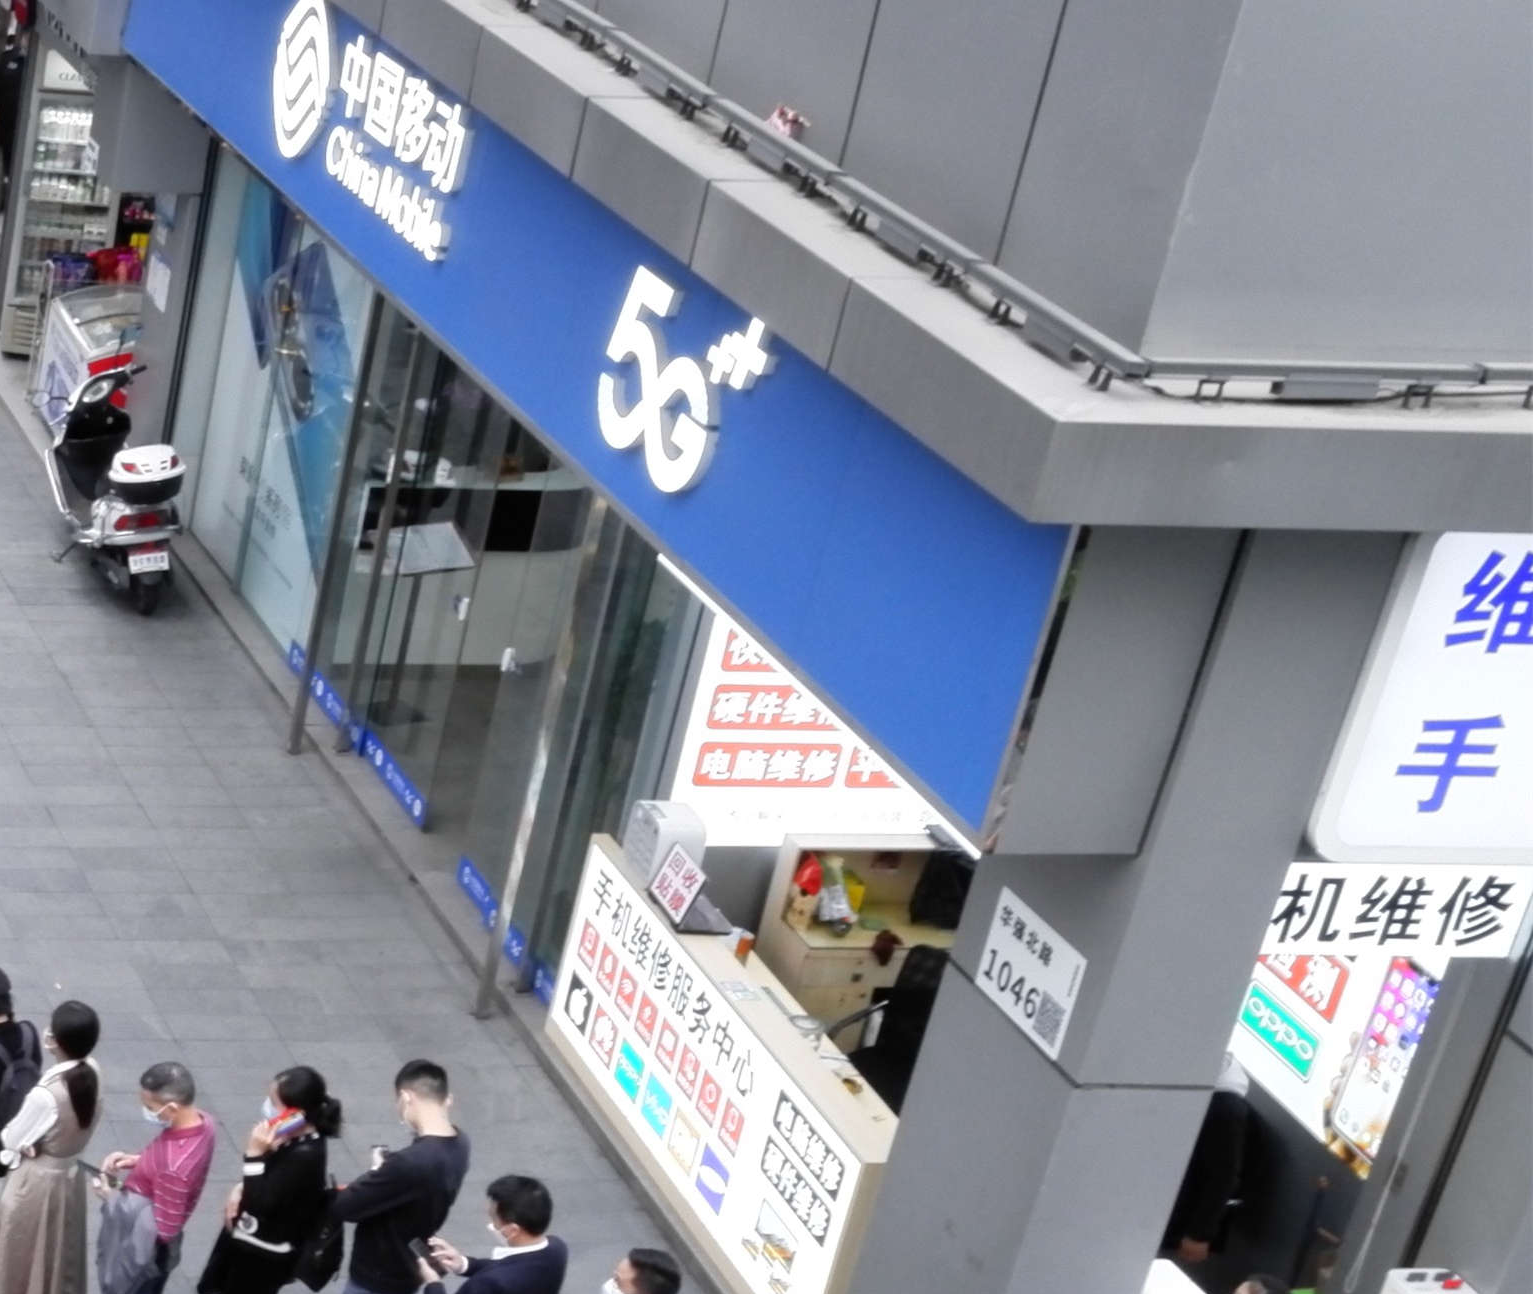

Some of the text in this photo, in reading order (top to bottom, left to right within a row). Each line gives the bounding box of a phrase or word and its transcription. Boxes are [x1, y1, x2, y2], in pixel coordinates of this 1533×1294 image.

[339, 34, 467, 195] 中国移动
[325, 125, 442, 262] China Mobile
[699, 748, 837, 782] 电脑维修
[1395, 714, 1506, 813] 手
[668, 850, 700, 895] 回收
[1269, 873, 1517, 947] 机维修
[592, 868, 755, 1098] 手机维修服务中心
[999, 904, 1054, 968] 华强北路
[982, 948, 1041, 1019] 1046
[762, 1142, 831, 1237] 硬件维修
[777, 1099, 844, 1193] 电脑维修
